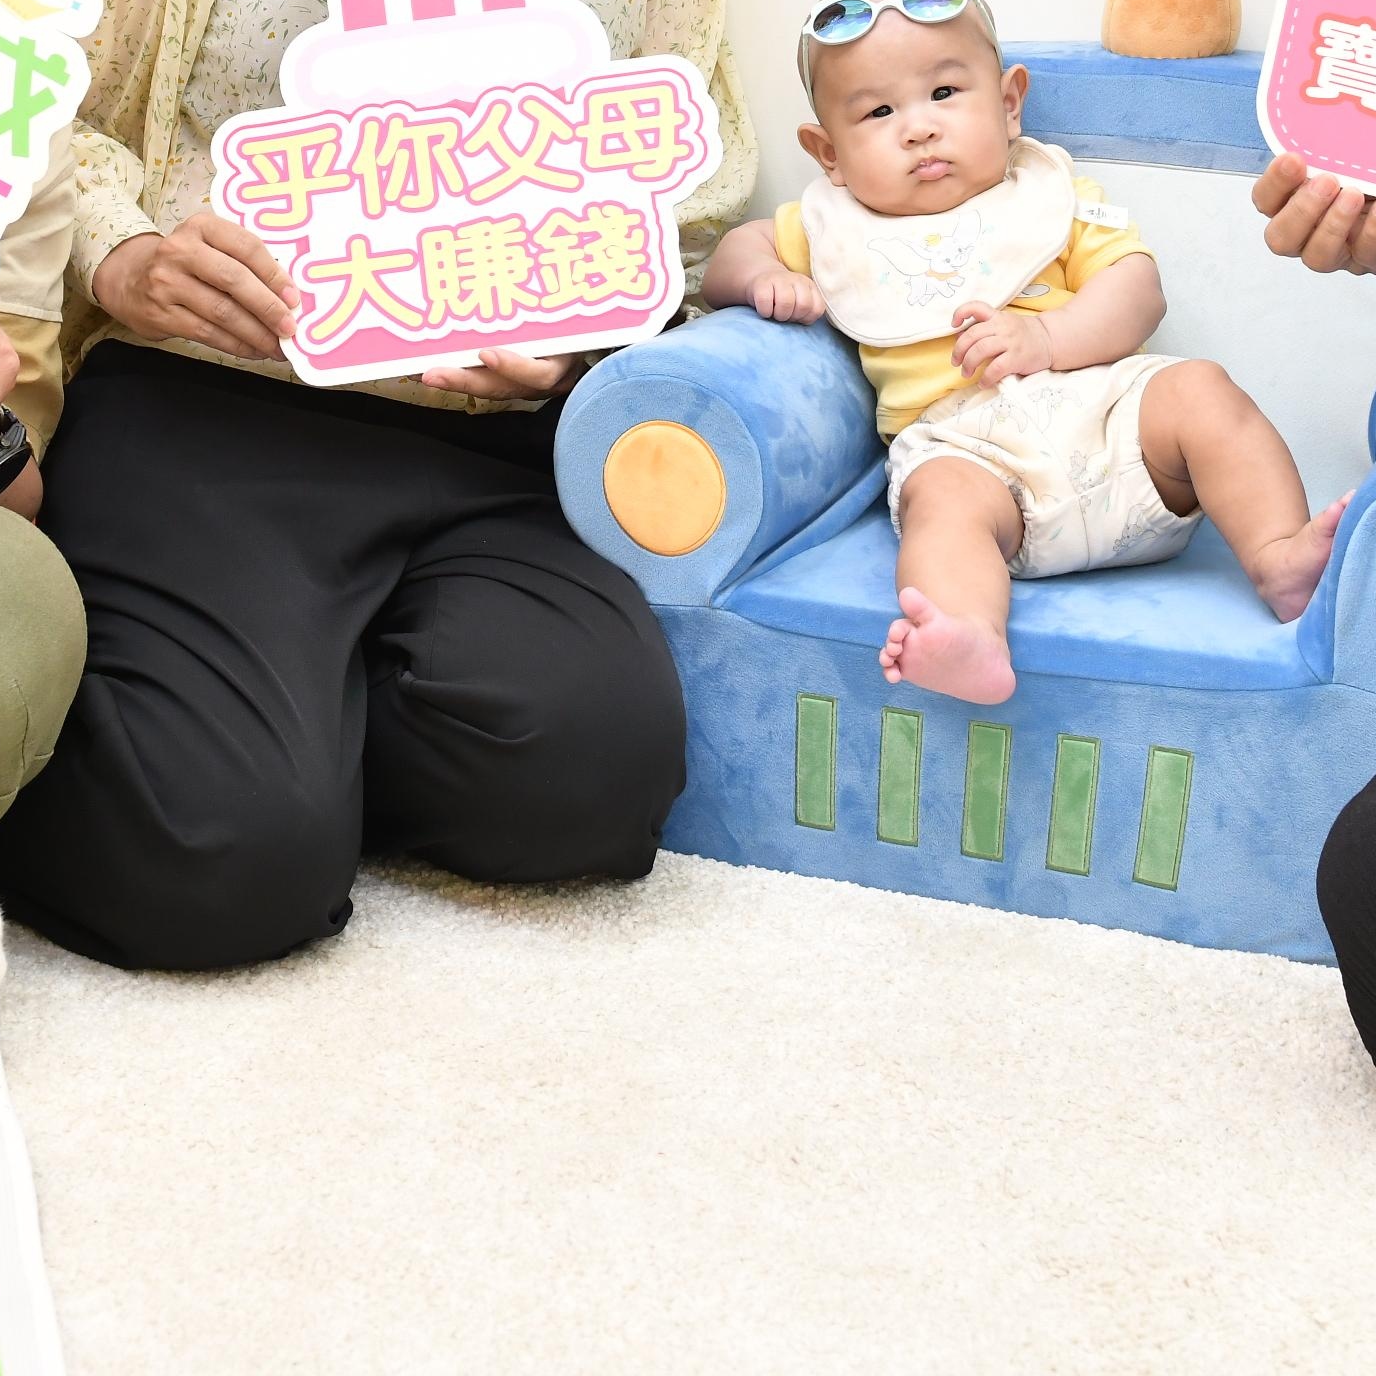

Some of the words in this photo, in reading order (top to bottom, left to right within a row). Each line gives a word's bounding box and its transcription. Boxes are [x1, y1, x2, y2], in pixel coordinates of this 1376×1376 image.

[240, 84, 692, 228] 乎你父母
[306, 203, 651, 342] 大賺錢
